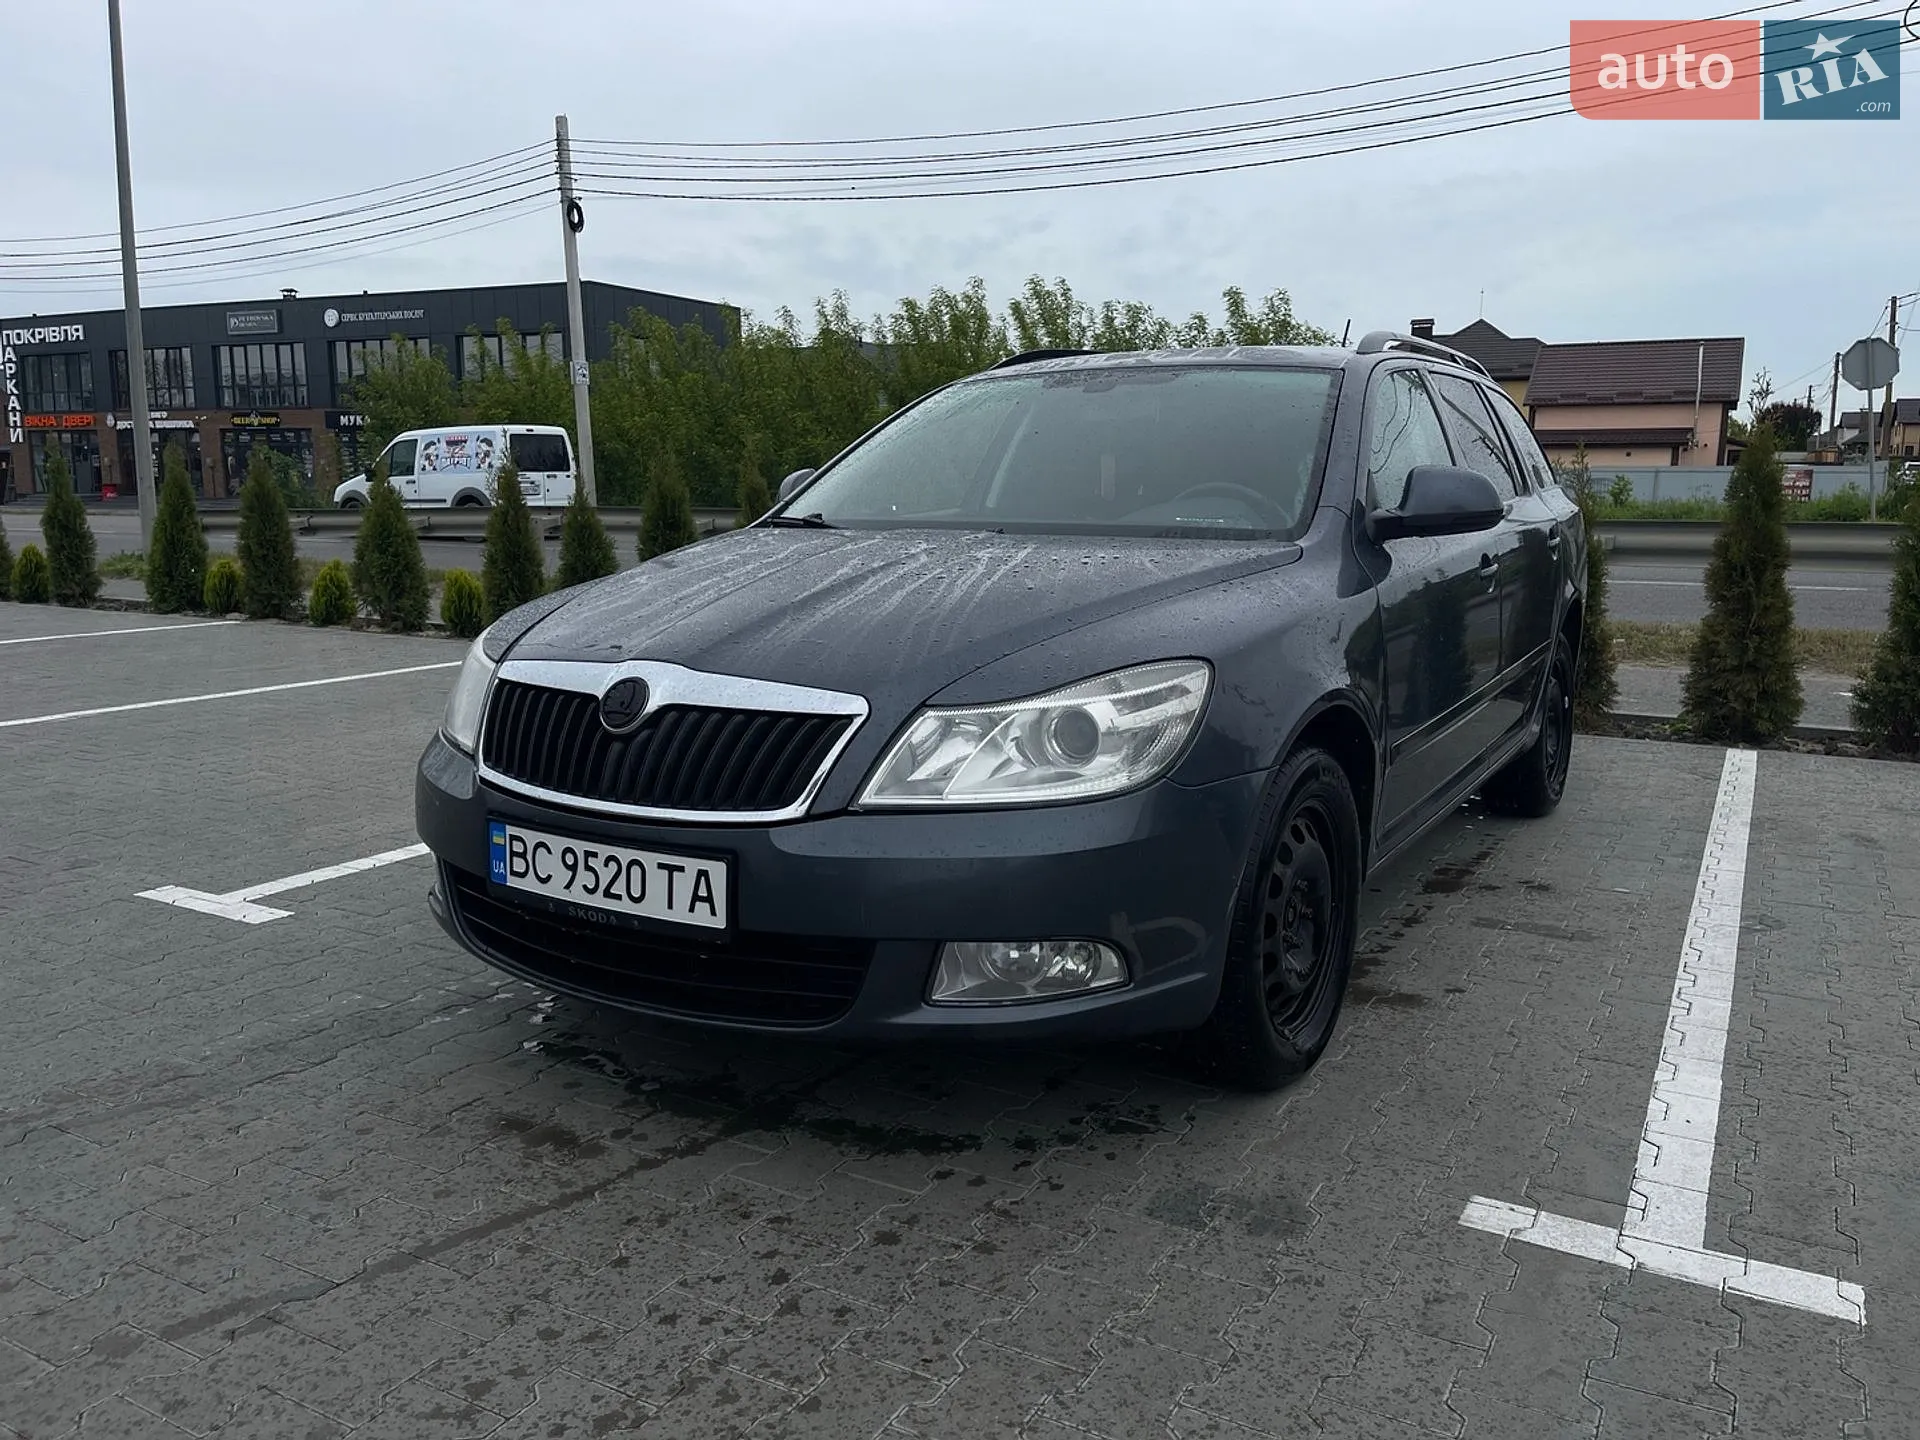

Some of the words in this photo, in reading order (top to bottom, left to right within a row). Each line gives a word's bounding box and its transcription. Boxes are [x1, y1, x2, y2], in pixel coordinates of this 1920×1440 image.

[2, 324, 84, 346] ПОКРІВЛЯ
[24, 415, 57, 427] ВІКНА
[62, 415, 96, 428] ДВЕРІ
[492, 860, 505, 874] UA
[508, 833, 553, 885] BC
[561, 846, 647, 904] 9520
[656, 861, 718, 917] TA
